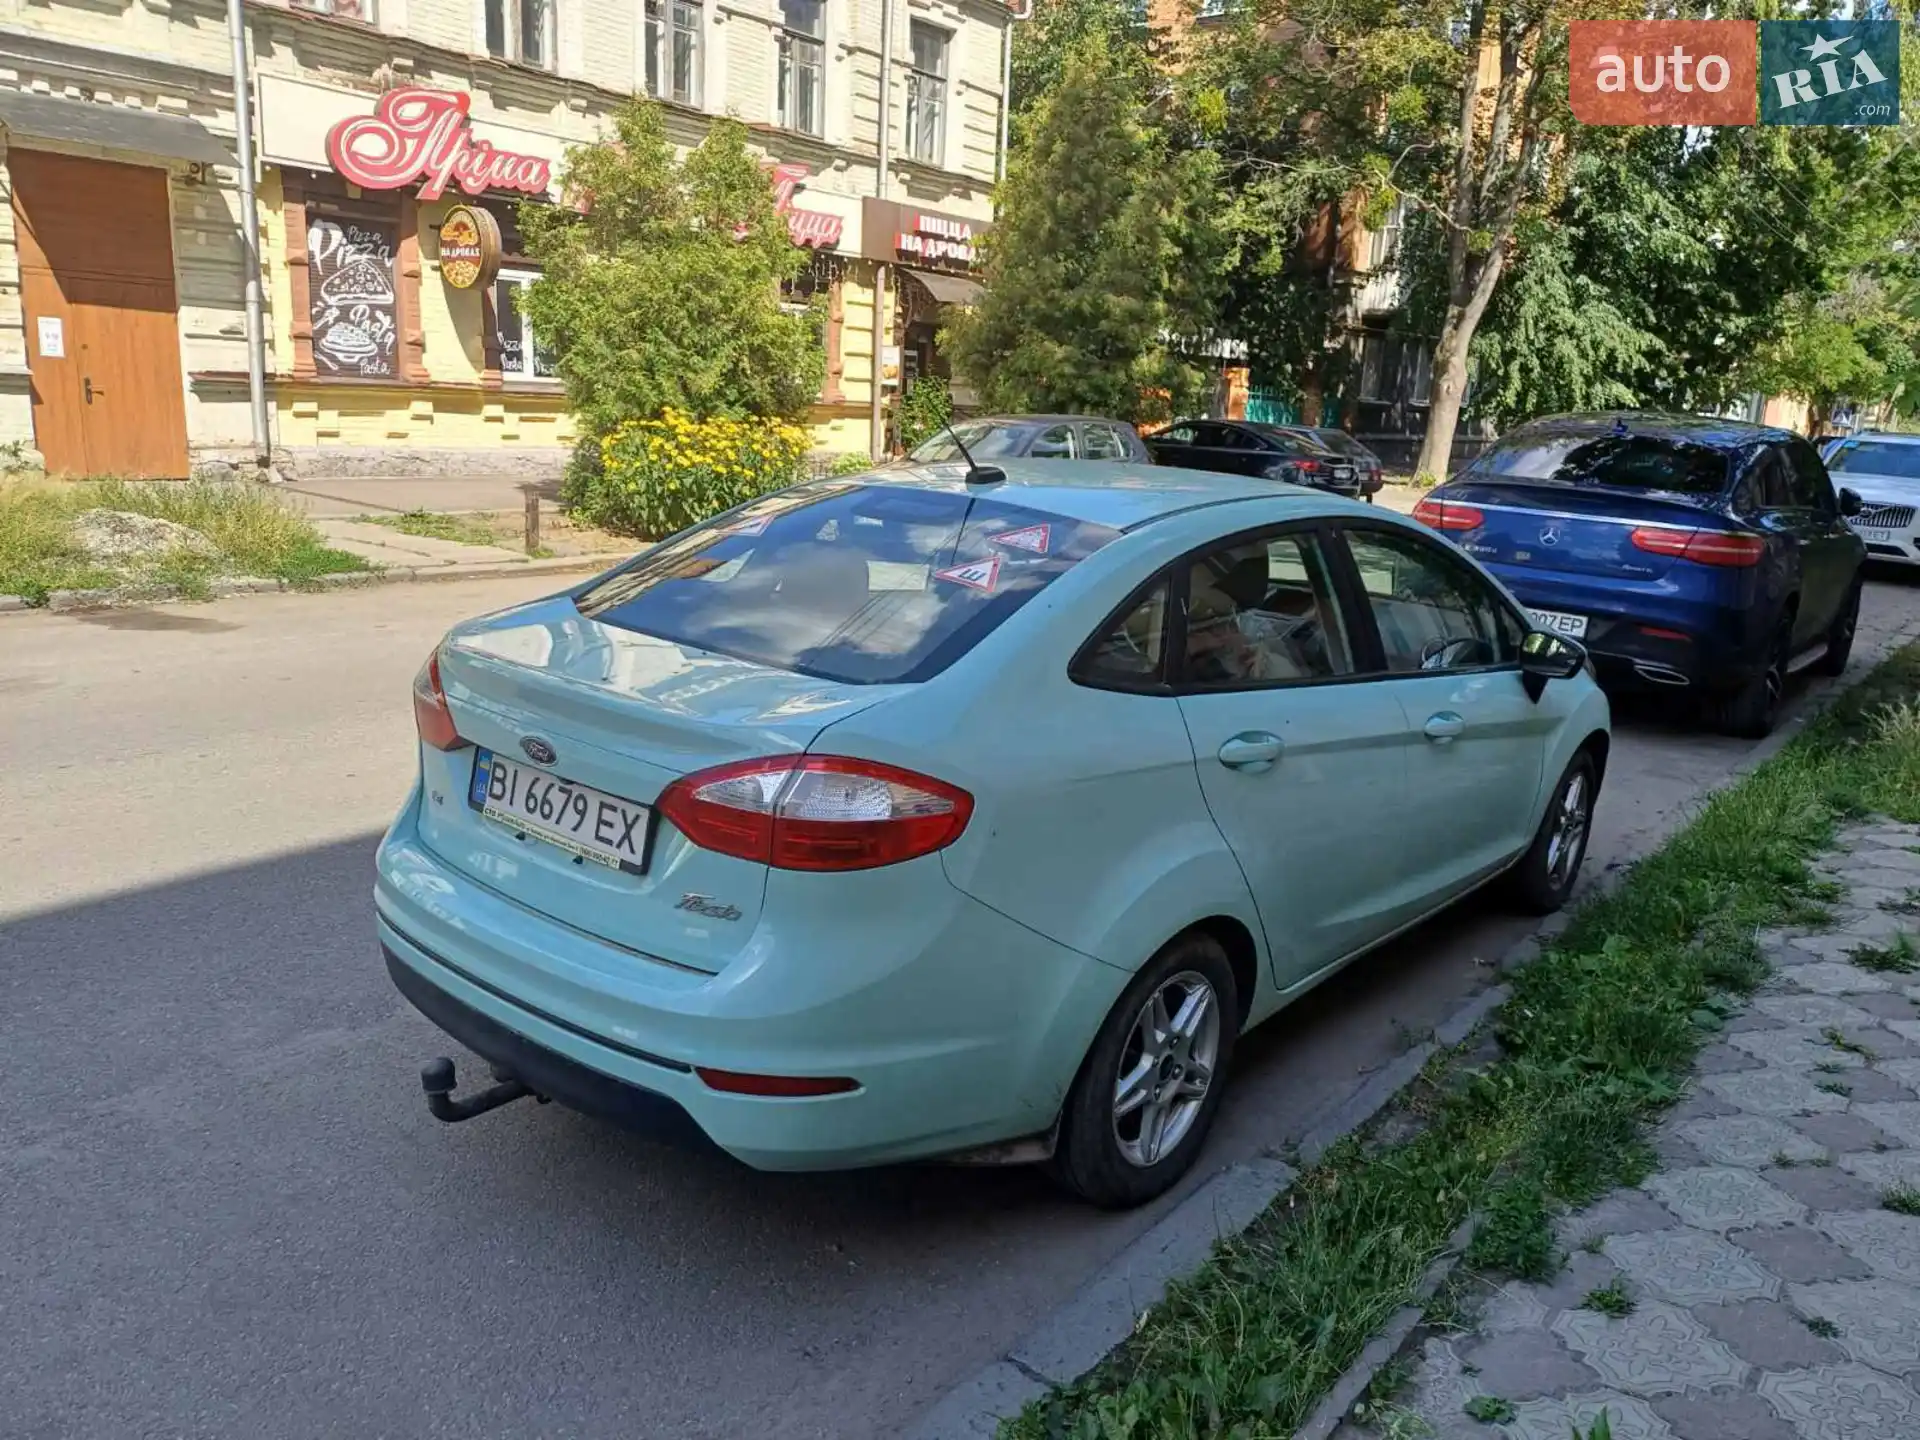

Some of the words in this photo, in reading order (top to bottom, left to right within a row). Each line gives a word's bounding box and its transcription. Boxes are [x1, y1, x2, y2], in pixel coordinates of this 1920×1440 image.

[308, 219, 392, 275] Pizza
[900, 233, 923, 253] НА
[1559, 615, 1584, 632] EP
[489, 762, 518, 807] BI
[525, 776, 588, 832] 6679
[594, 800, 641, 855] EX
